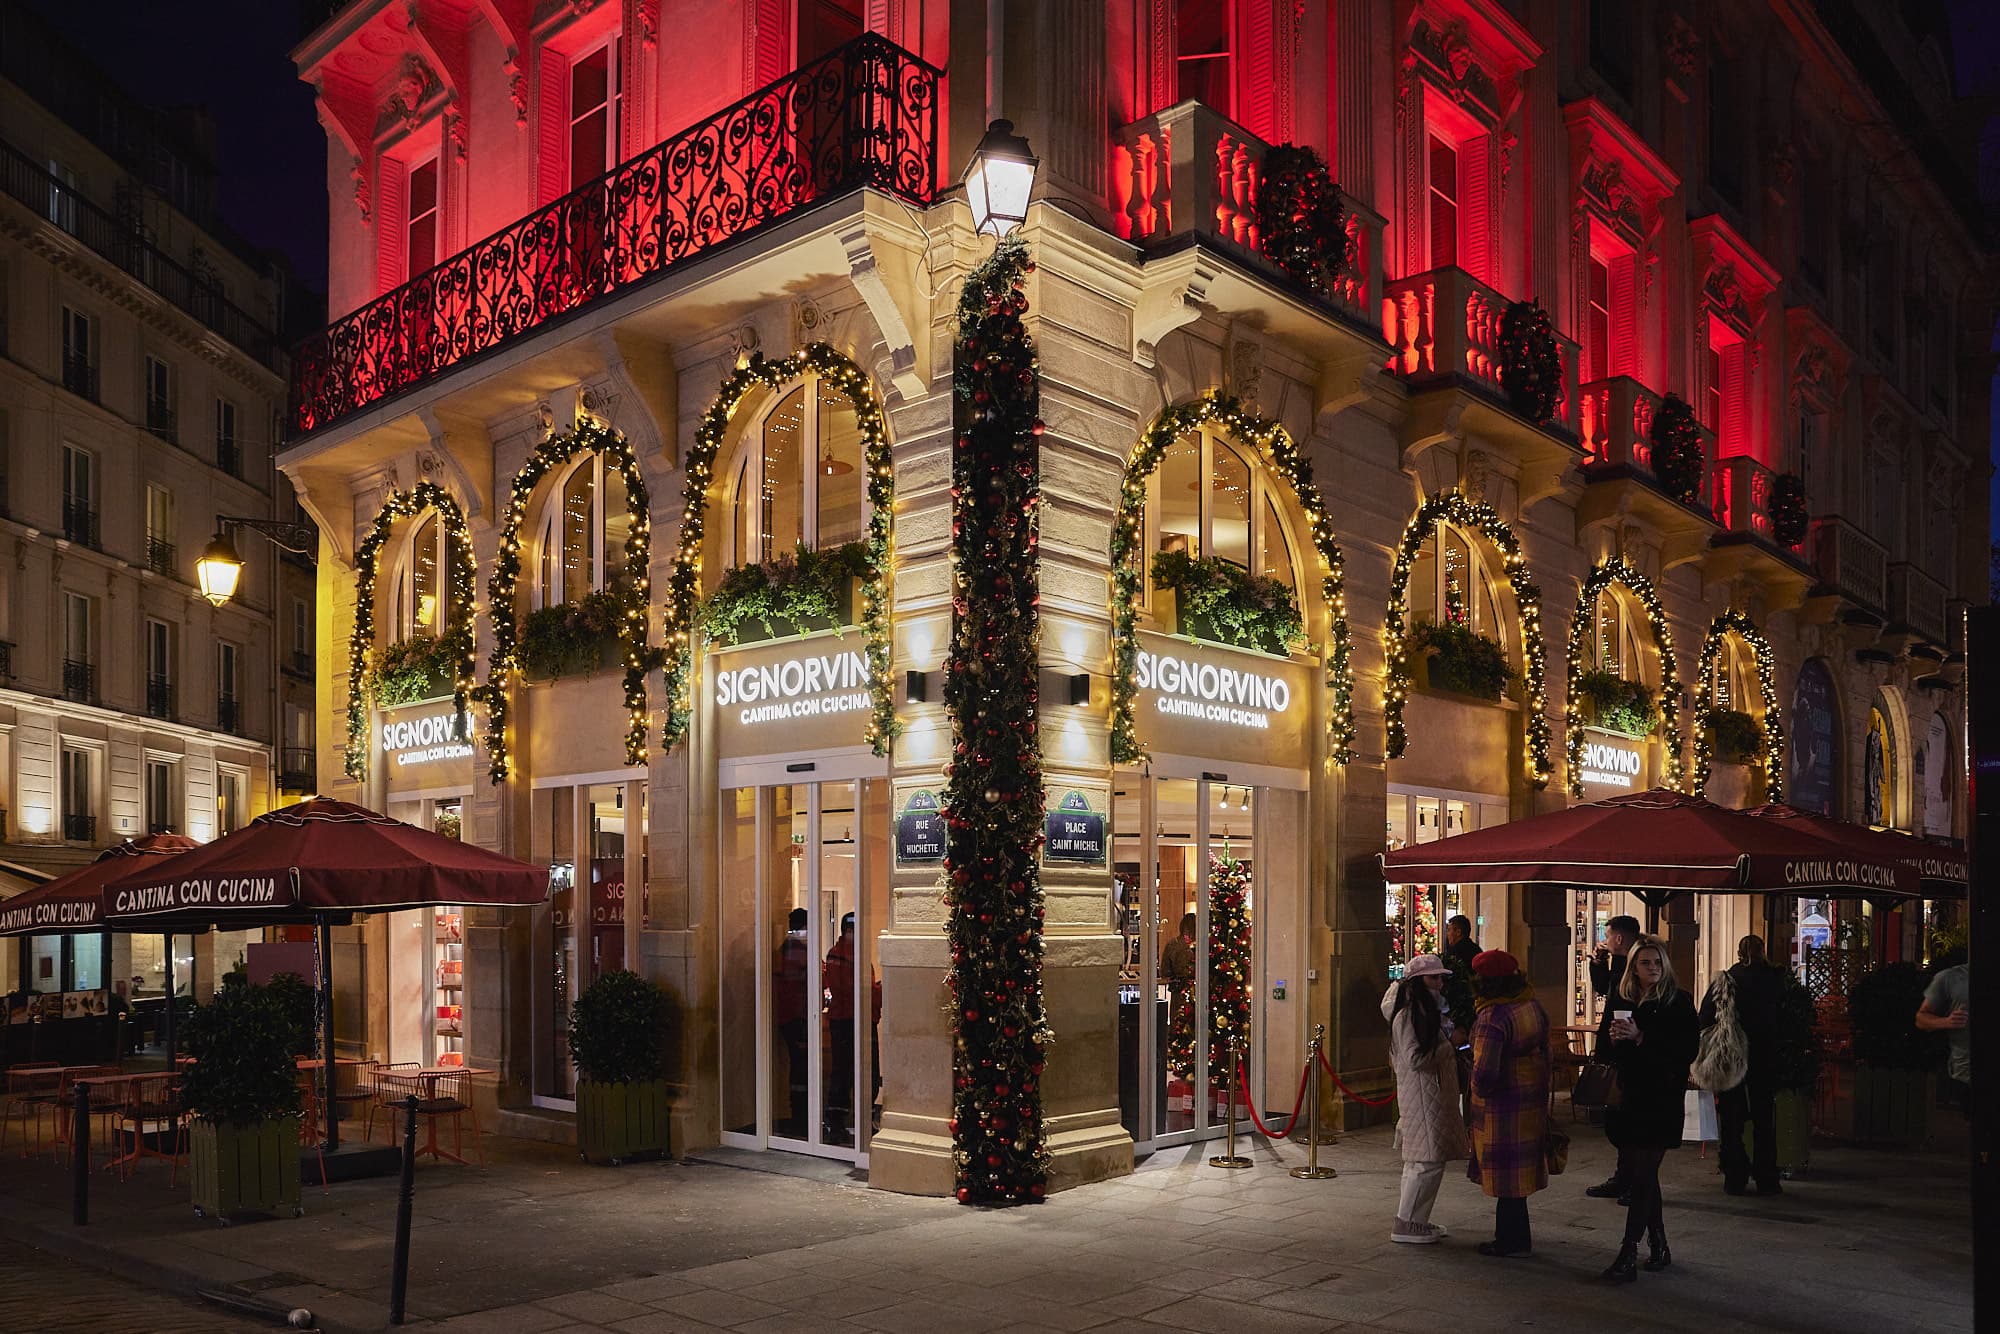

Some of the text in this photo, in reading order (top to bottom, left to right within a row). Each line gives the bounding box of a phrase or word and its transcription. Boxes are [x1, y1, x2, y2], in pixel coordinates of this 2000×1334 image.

[716, 651, 871, 706] SIGNORVIN
[1136, 651, 1289, 712] SIGNORVINO
[740, 692, 872, 724] CANTINA CON CUCINA
[1157, 697, 1269, 729] CANTINA CON CUCINA
[915, 820, 929, 830] RUE
[1065, 822, 1087, 834] PLACE
[906, 843, 939, 854] HUCHETTE
[1052, 839, 1100, 852] SAINT MICHEL
[1785, 861, 1834, 884] CANTINA
[1835, 861, 1858, 882] CON
[1860, 863, 1897, 888] CUCINA
[1925, 858, 1943, 877] CON
[115, 878, 275, 912] CANTINA CON CUCINA
[0, 907, 32, 931] ANTINA
[36, 903, 58, 924] CON
